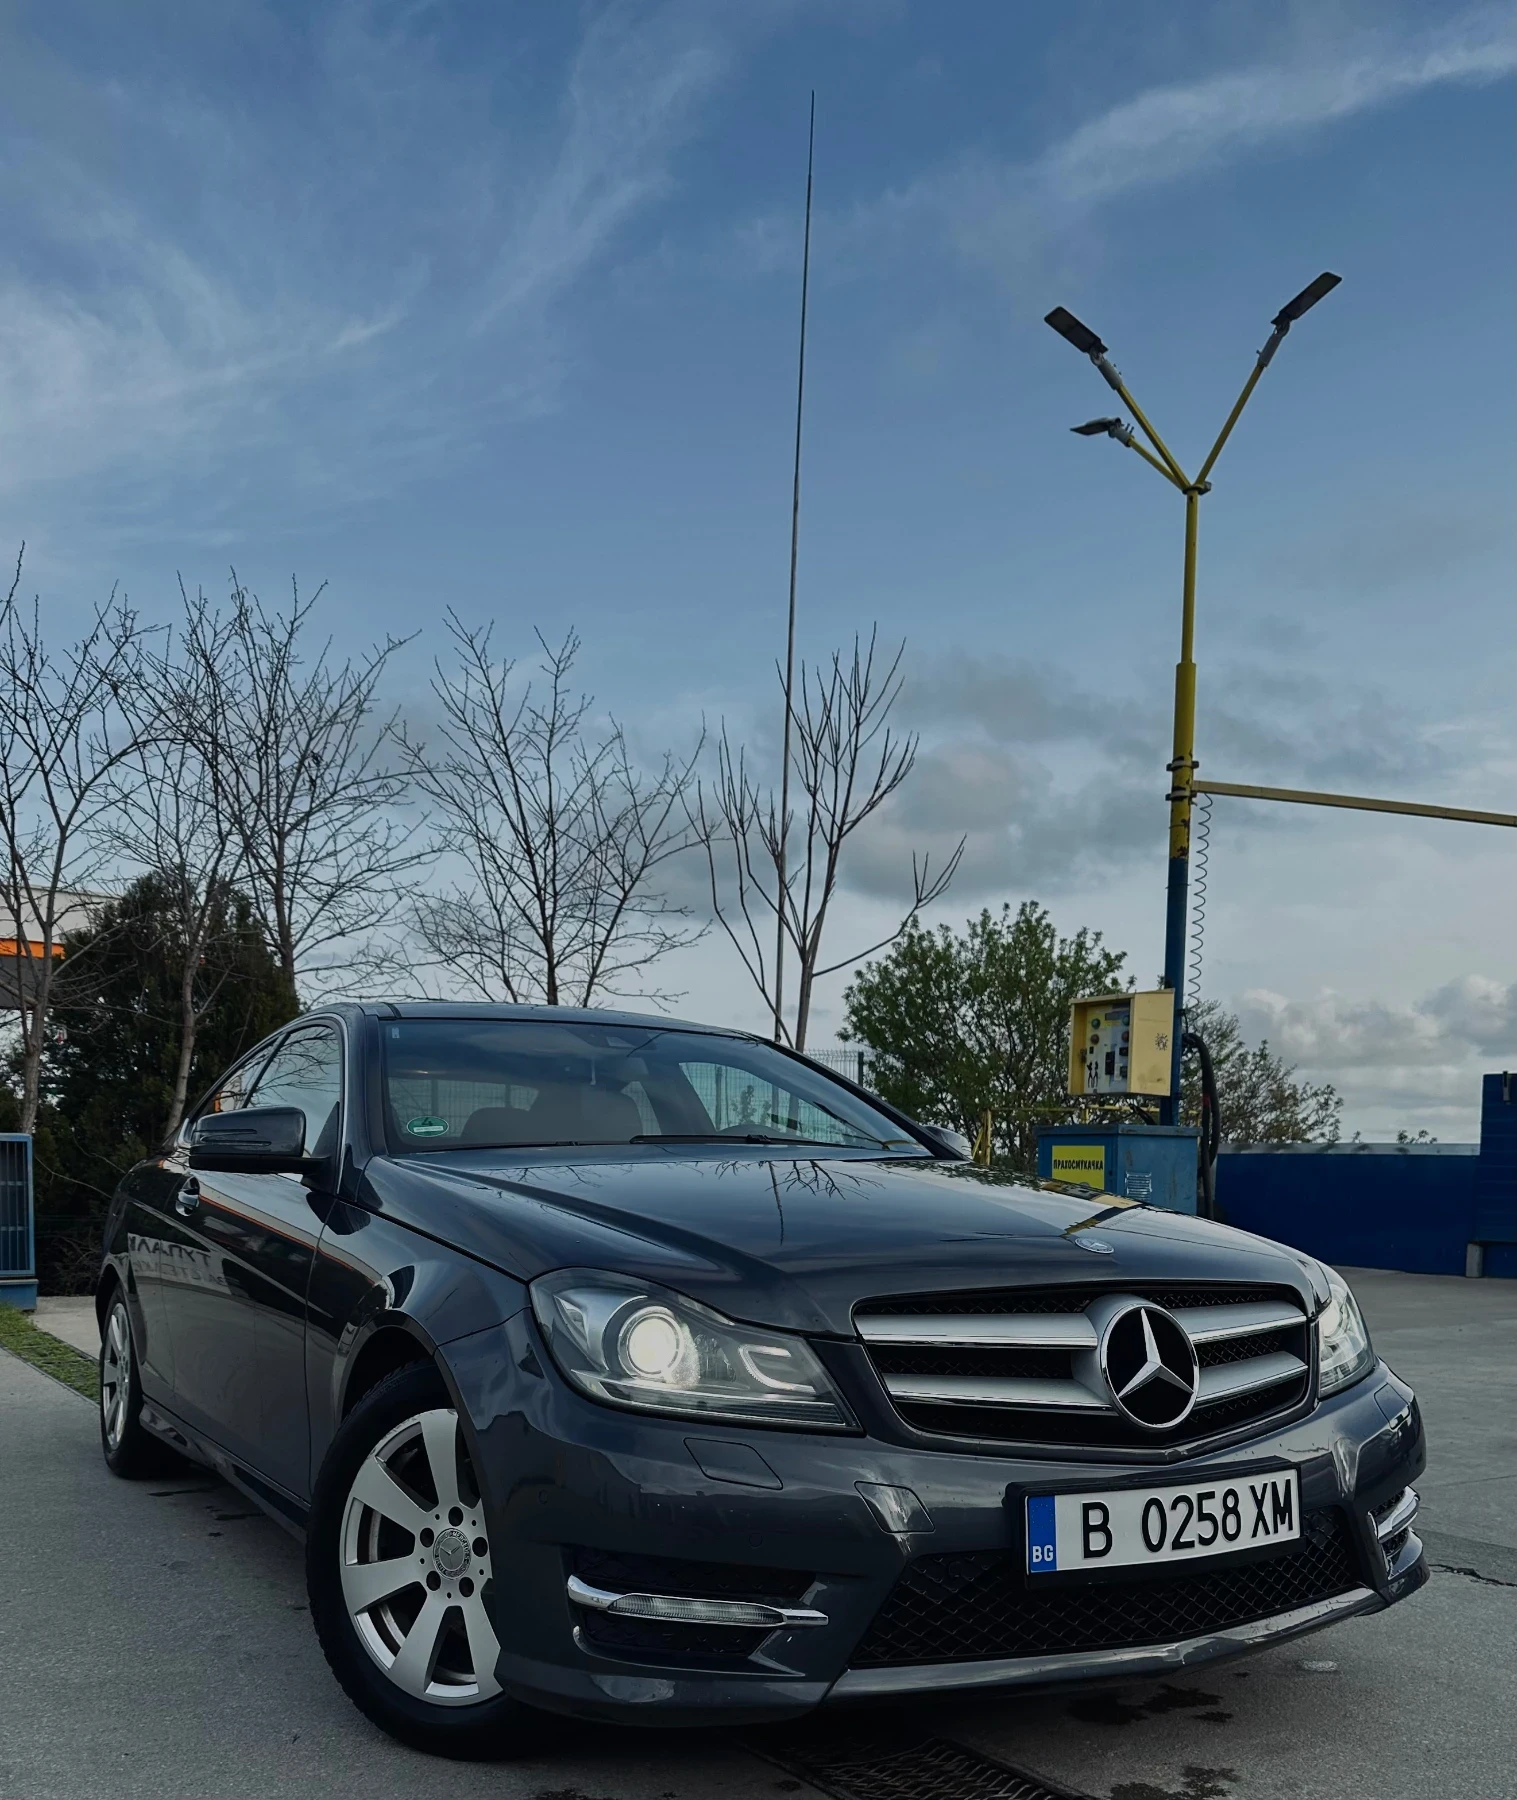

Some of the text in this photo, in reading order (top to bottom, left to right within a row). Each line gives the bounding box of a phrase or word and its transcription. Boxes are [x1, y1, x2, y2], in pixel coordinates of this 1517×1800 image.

[1053, 1159, 1103, 1170] ПРАХОСМУКАЧКА
[1082, 1478, 1293, 1559] B 0258 XM
[1032, 1545, 1054, 1563] BG
